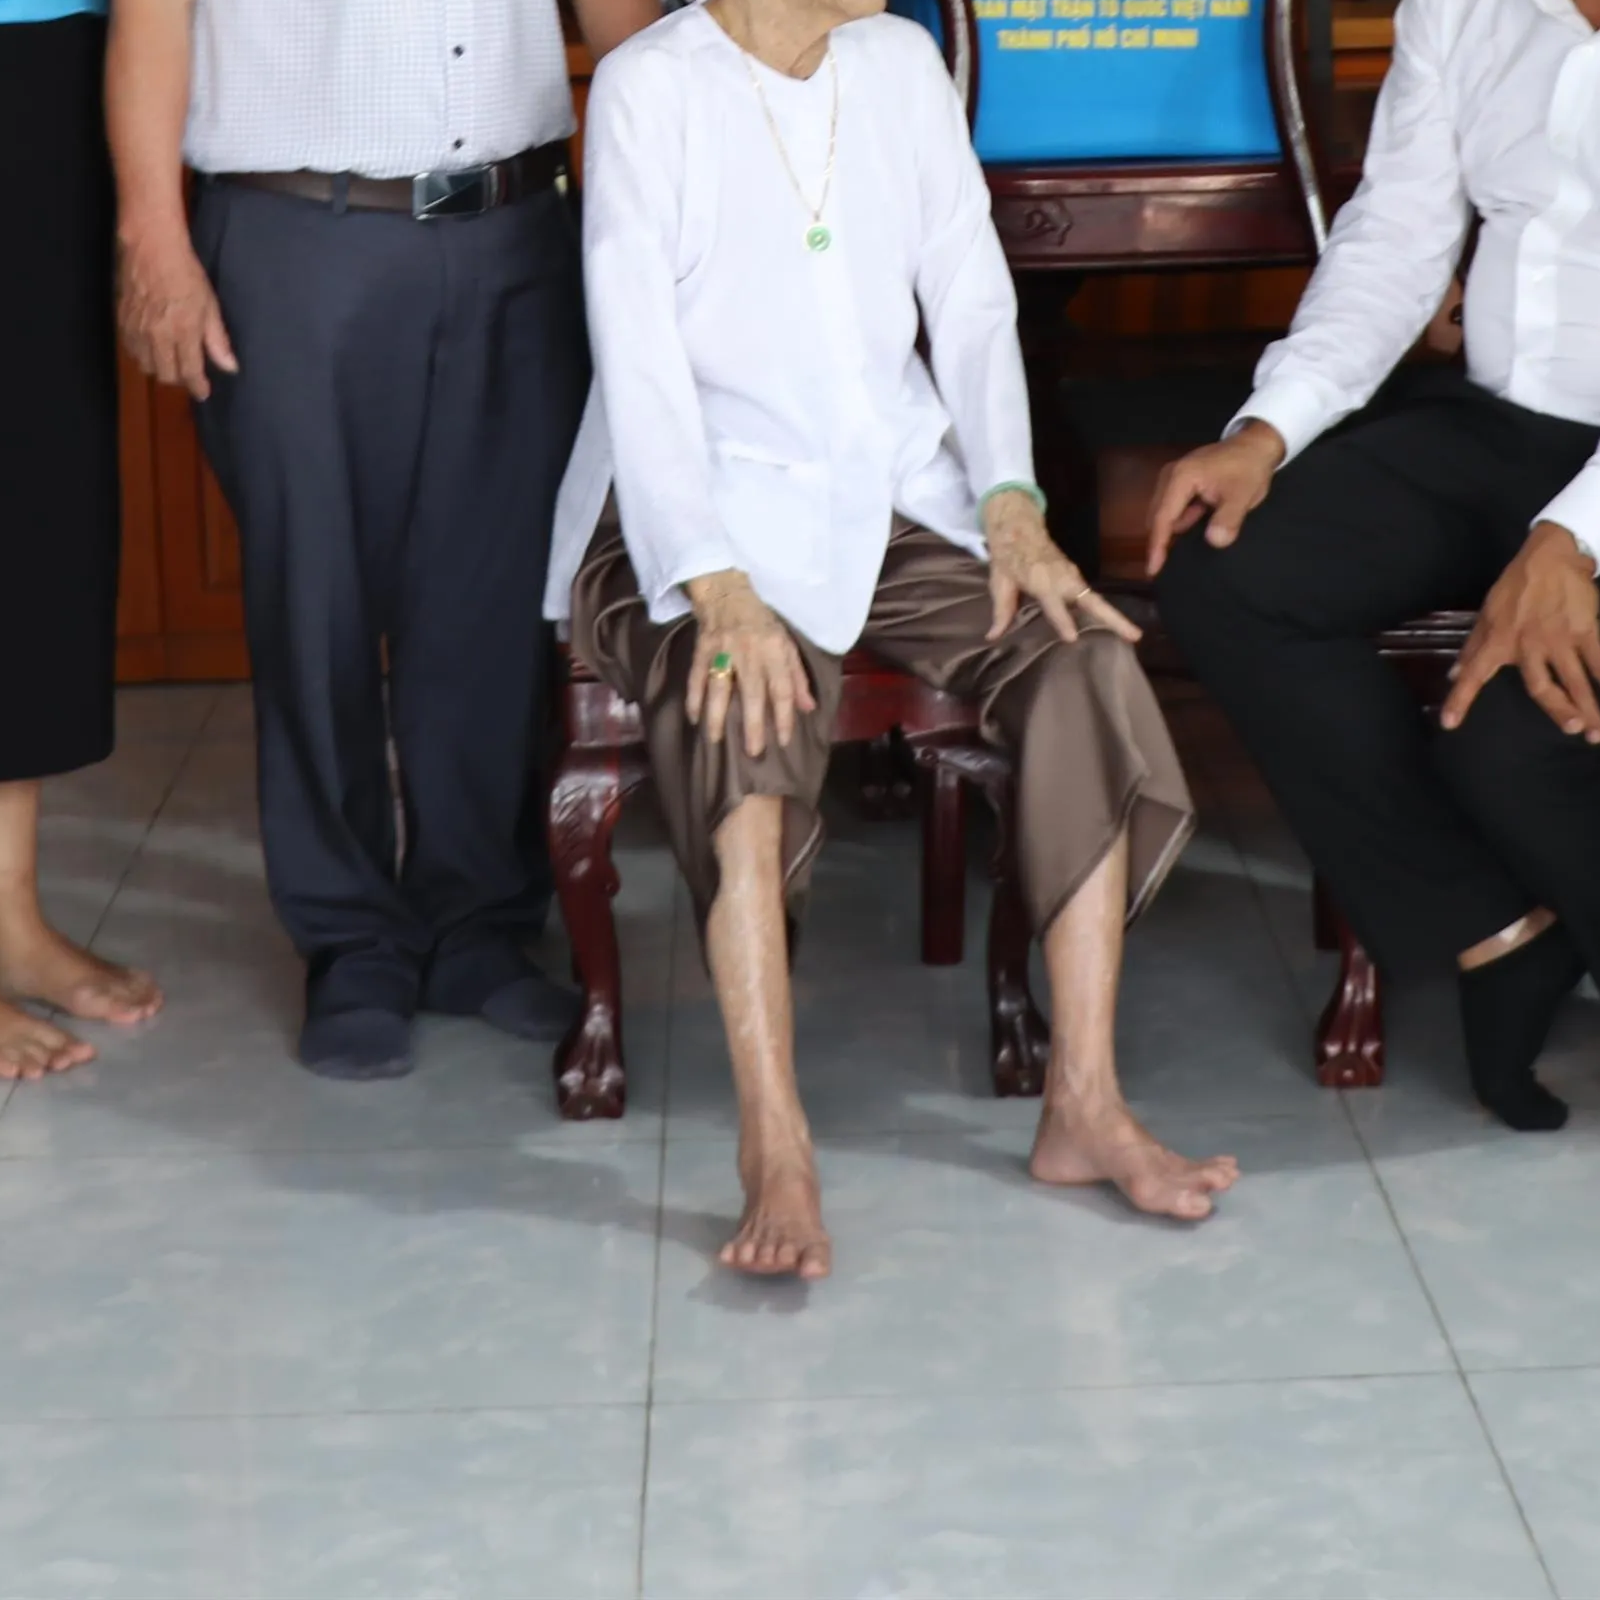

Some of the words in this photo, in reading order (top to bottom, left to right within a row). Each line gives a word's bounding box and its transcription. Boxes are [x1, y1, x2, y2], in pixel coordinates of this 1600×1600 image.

[997, 26, 1053, 49] THÀNH
[1056, 22, 1092, 49] PHỐ
[1120, 24, 1150, 49] CHÍ
[1152, 27, 1199, 49] MINH
